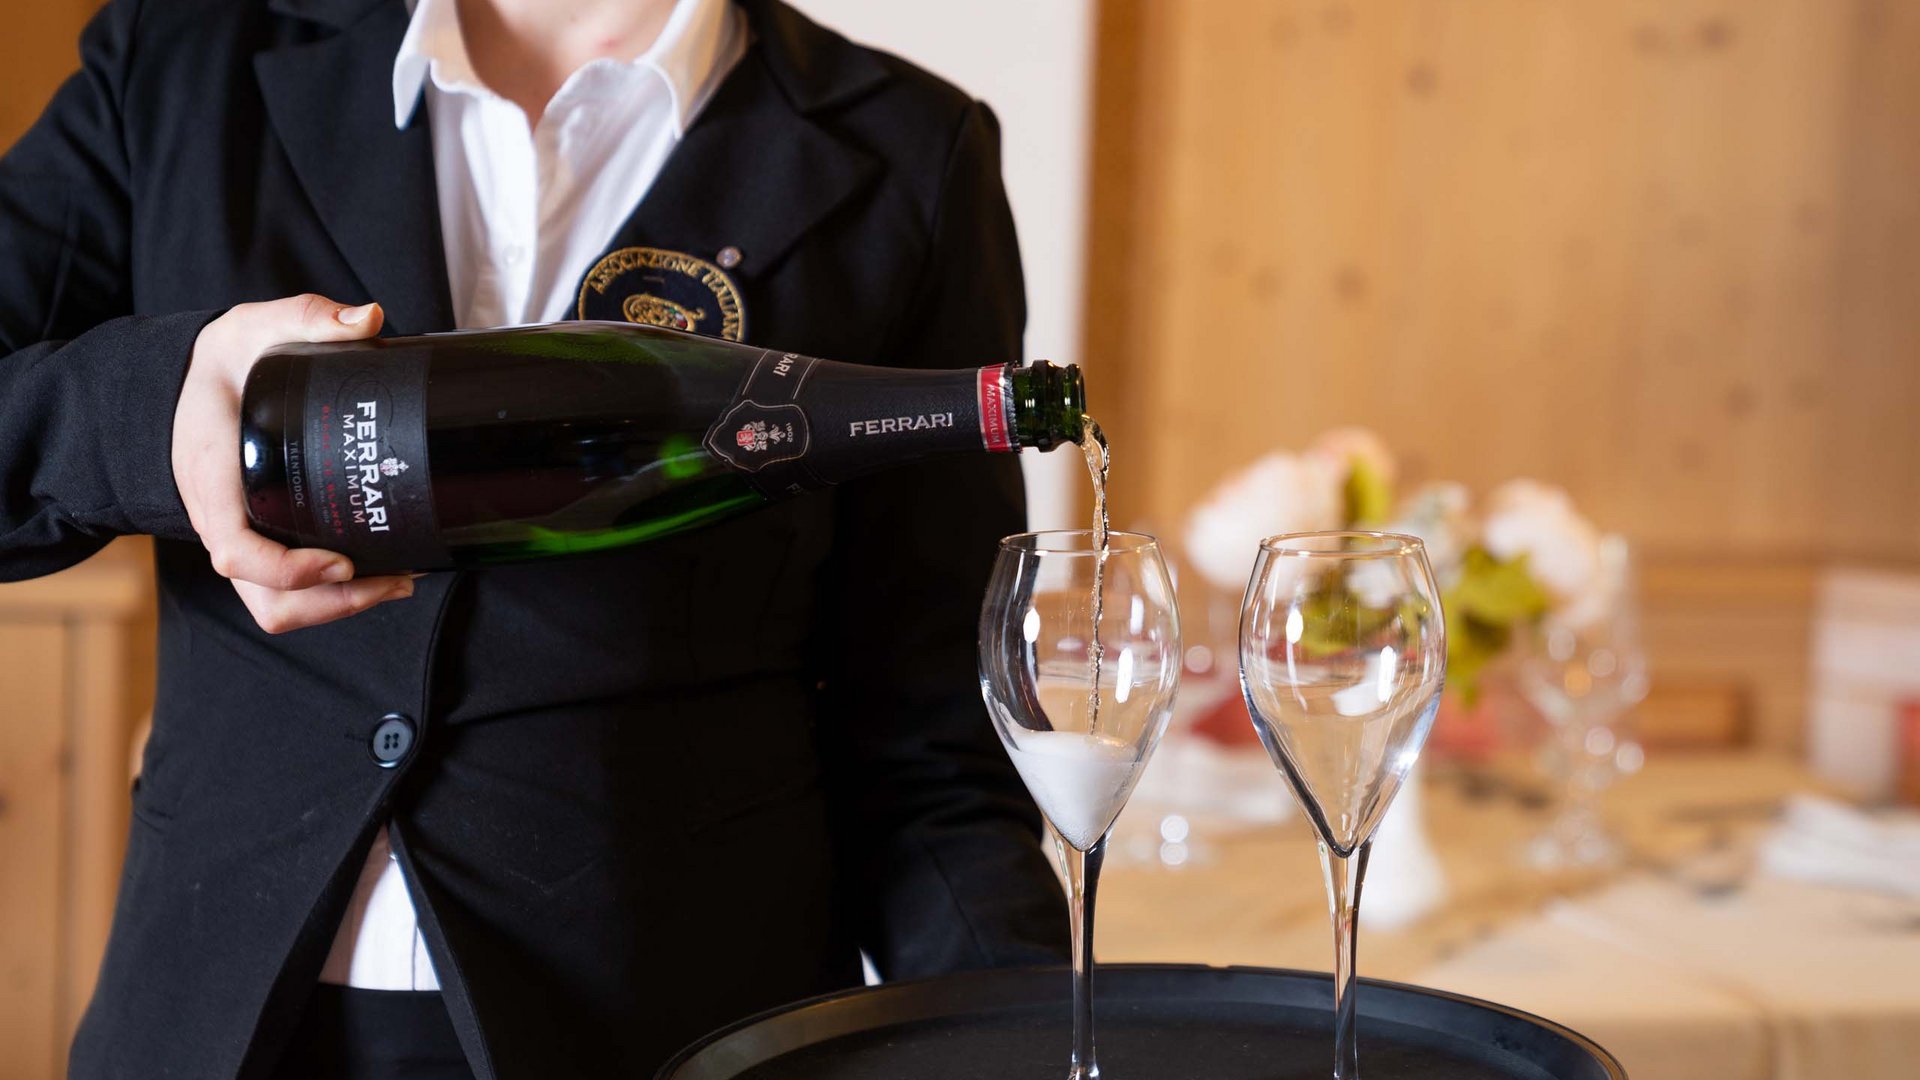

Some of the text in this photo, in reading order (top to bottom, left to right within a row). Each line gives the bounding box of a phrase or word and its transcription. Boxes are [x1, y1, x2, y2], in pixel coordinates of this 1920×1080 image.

[588, 251, 700, 295] ASSOCIAZIONE
[849, 412, 953, 437] FERRARI
[985, 383, 1001, 444] MAXIMUM
[289, 440, 305, 508] TRENTODOC
[342, 414, 366, 524] MAXIMUM
[356, 400, 390, 533] FERRARI
